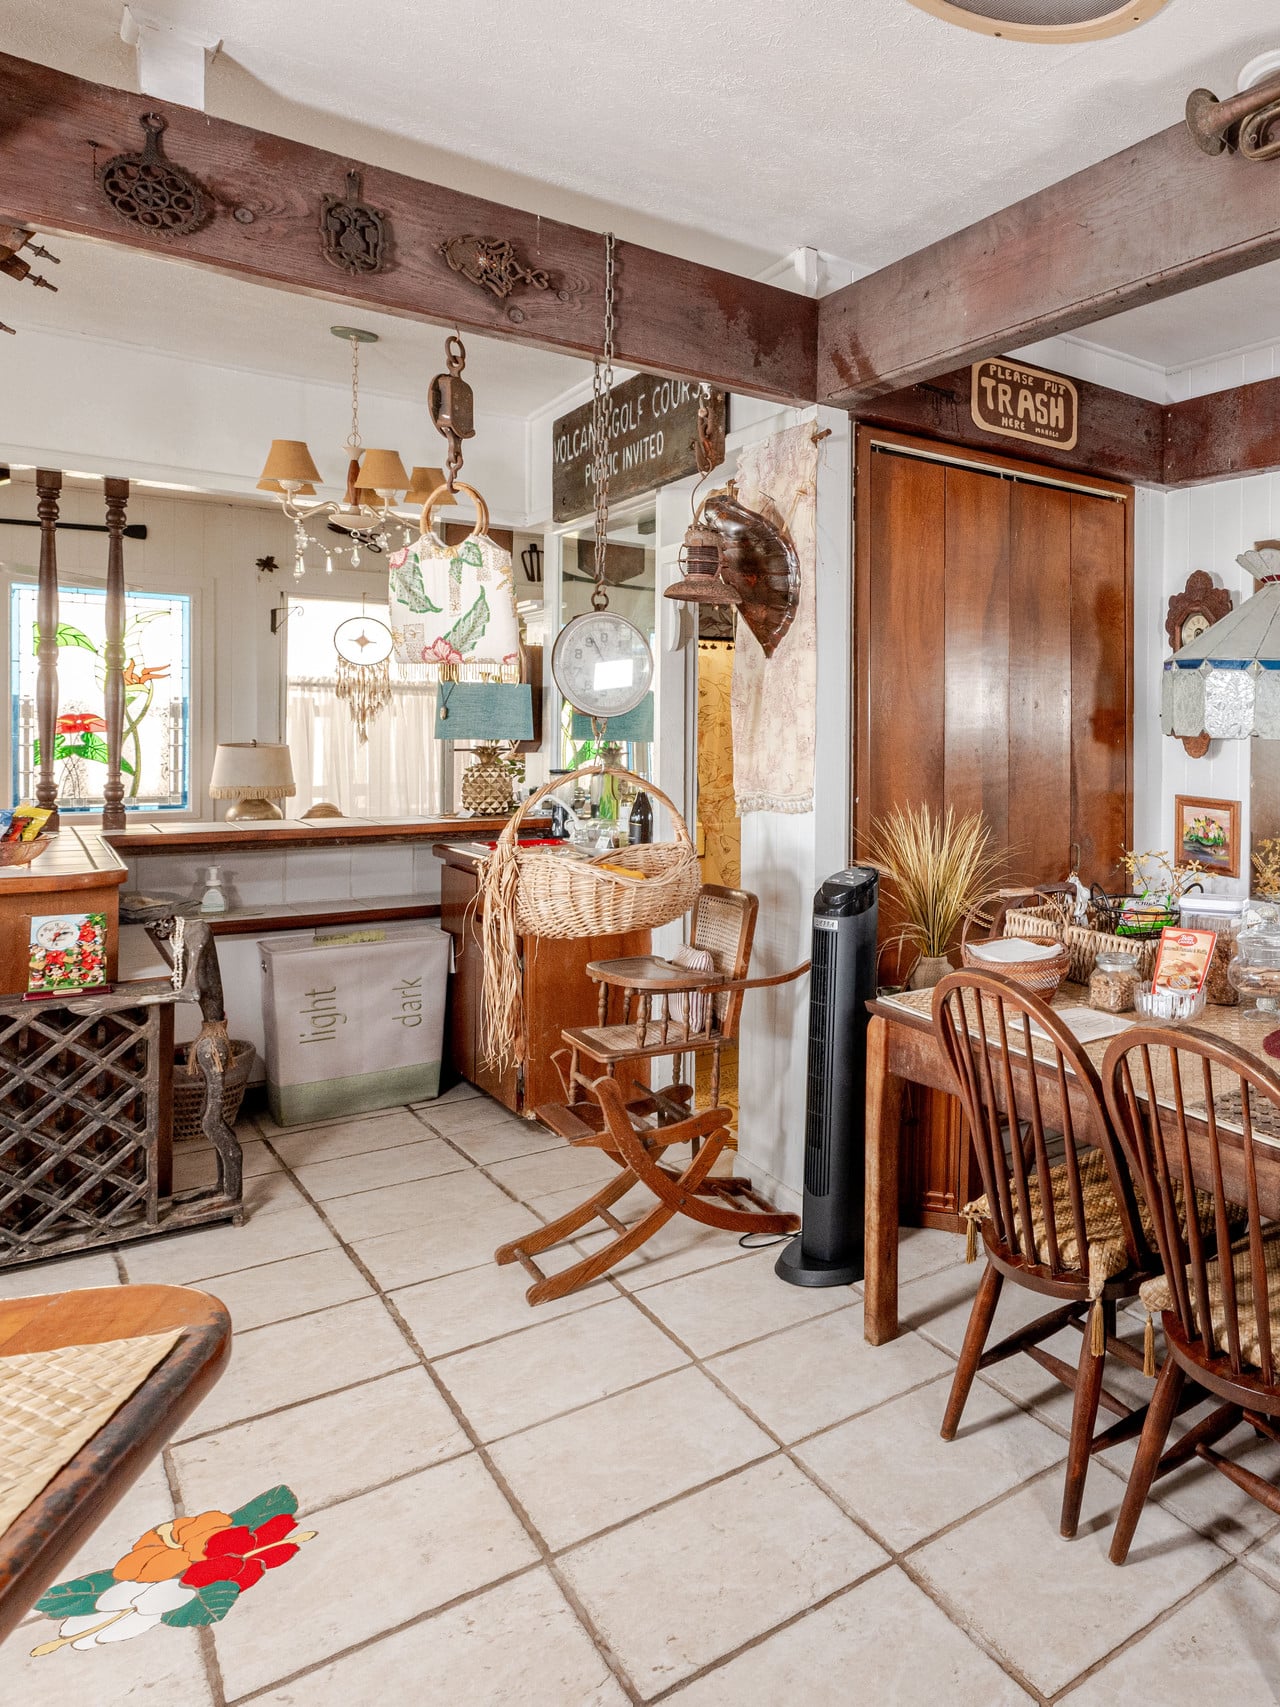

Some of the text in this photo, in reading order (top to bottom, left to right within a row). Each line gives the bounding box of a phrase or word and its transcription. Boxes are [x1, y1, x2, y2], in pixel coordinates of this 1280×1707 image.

[981, 376, 1065, 429] TRASH
[989, 364, 1066, 395] PLEASE PUT
[553, 380, 701, 464] VOLCAN GOLF COUR
[1001, 417, 1059, 438] HERE MAHALO
[585, 430, 664, 488] PULIC INVITED
[299, 985, 348, 1045] light
[391, 976, 423, 1028] dark
